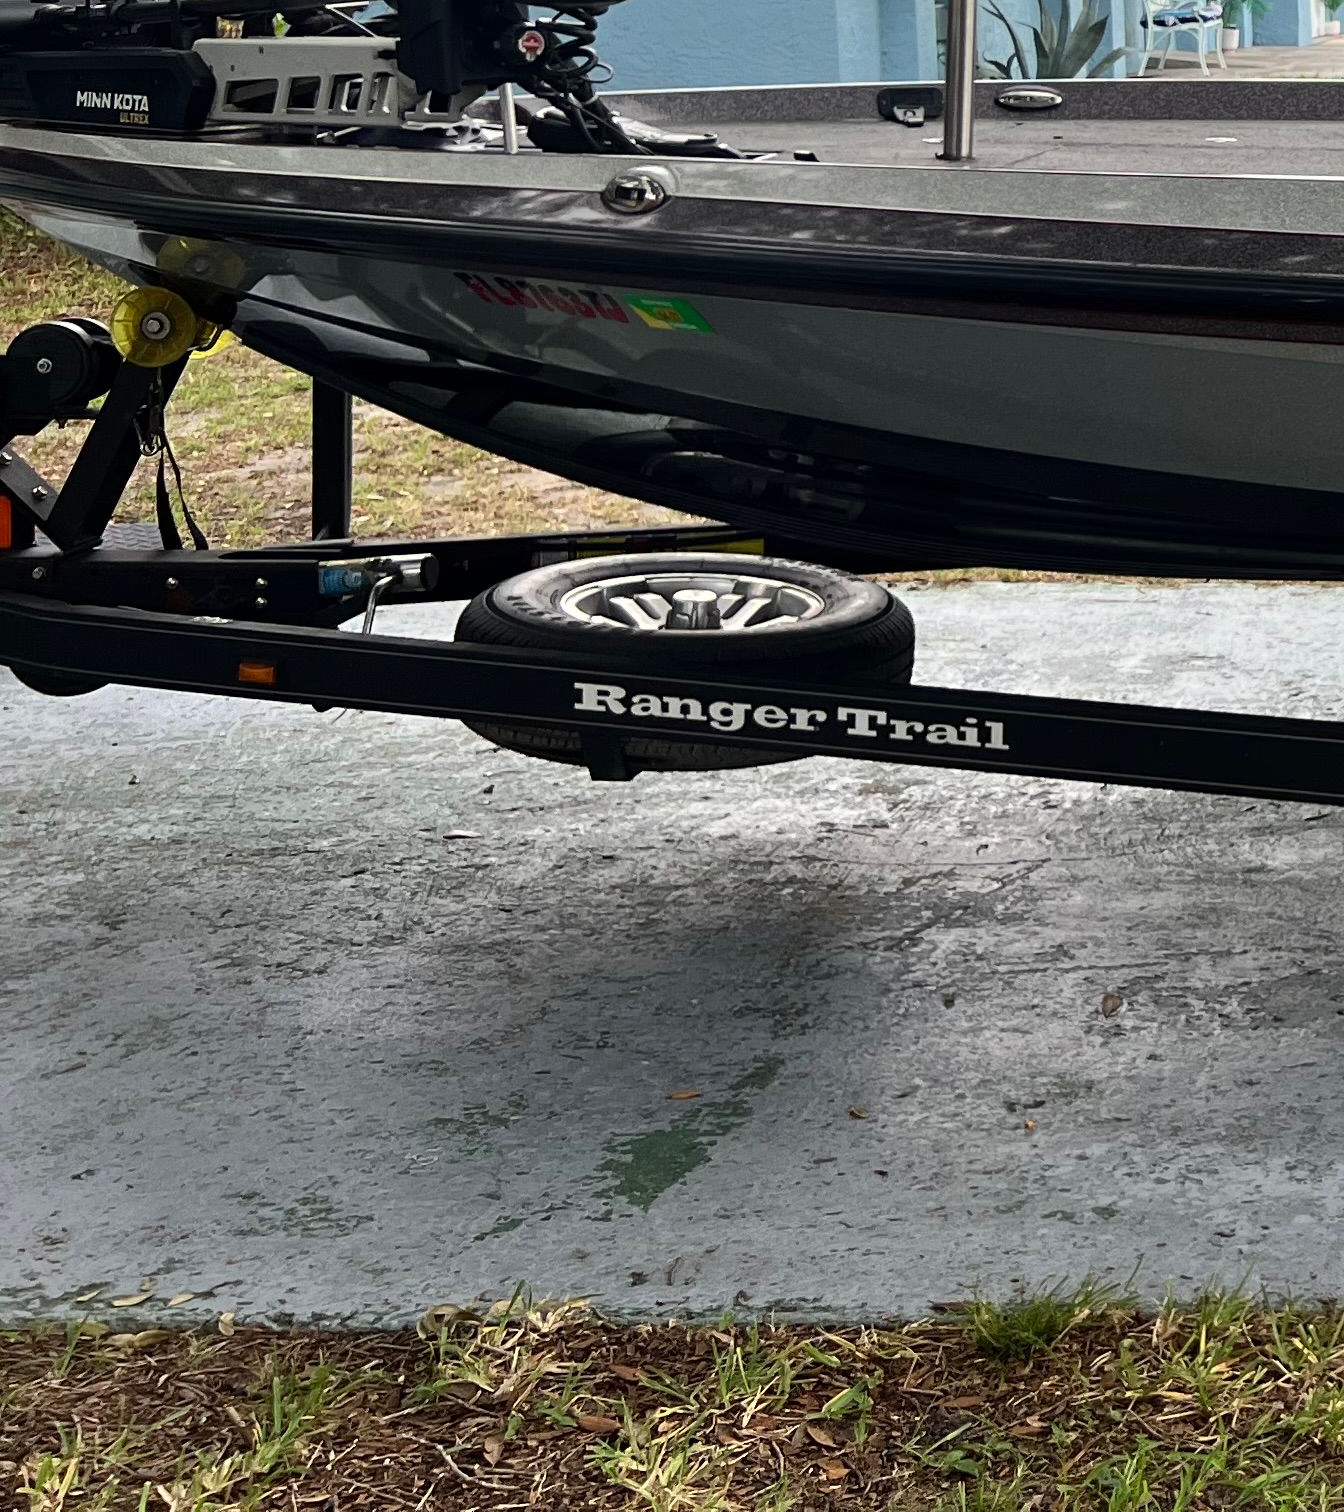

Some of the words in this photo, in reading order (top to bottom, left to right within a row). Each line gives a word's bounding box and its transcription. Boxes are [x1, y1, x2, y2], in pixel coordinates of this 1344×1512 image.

[76, 91, 111, 109] MINN
[113, 93, 149, 111] KOTA
[574, 682, 827, 732] Ranger
[837, 706, 1010, 750] Trail
